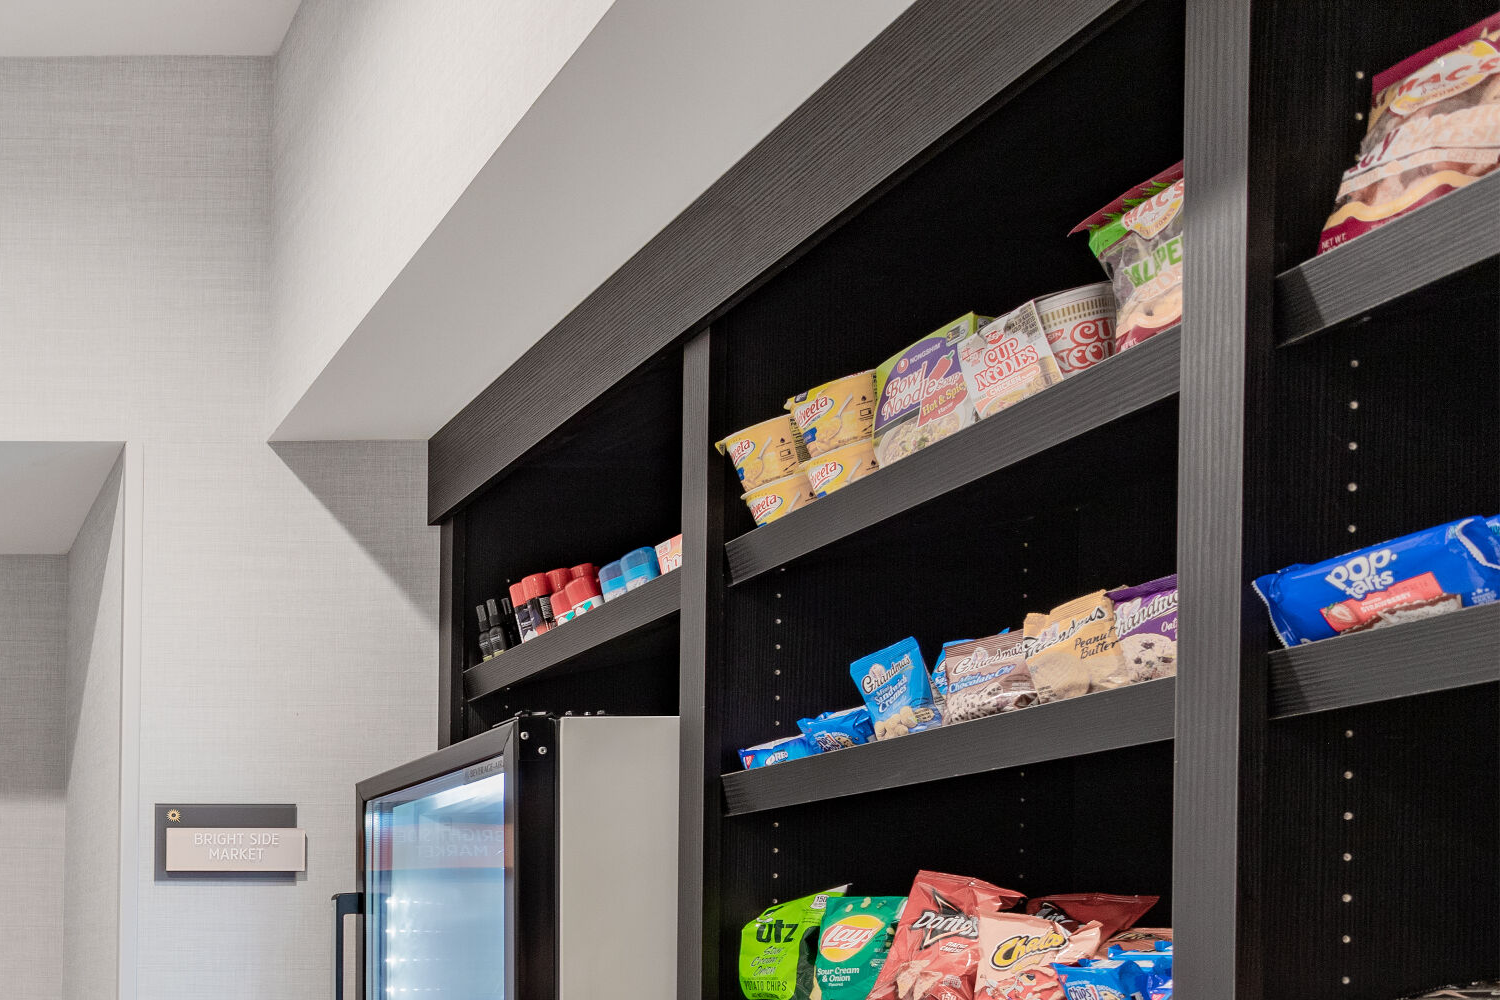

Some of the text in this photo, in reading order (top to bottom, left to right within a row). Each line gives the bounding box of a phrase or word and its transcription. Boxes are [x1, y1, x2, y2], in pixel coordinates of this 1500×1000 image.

[1070, 317, 1116, 345] CU
[984, 337, 1019, 367] CUP
[975, 345, 1039, 392] NOODLES
[1074, 626, 1116, 650] Peanut
[1080, 639, 1120, 660] Butter
[874, 674, 908, 705] Sandwich
[194, 833, 280, 845] BRIGHT SIDE
[209, 848, 264, 860] MARKET
[912, 911, 980, 938] Doritos
[817, 966, 860, 976] Sour Cream
[822, 974, 851, 983] & Onion
[766, 980, 787, 992] CHIPS
